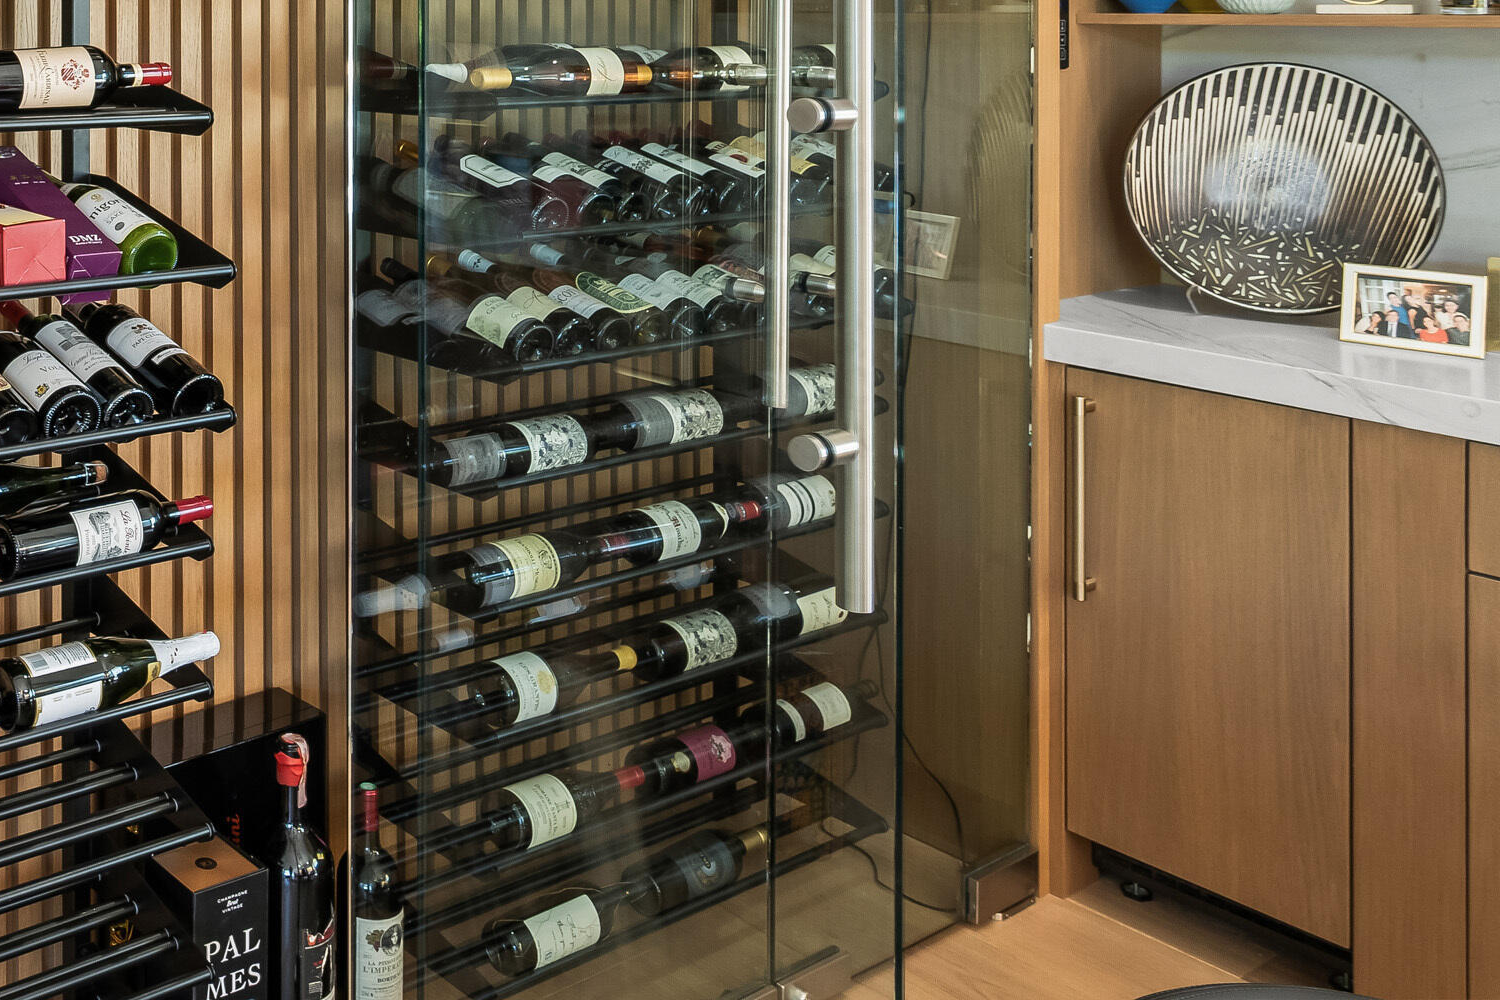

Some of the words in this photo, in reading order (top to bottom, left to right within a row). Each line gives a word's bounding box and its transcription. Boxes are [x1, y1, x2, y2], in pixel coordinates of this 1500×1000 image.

[68, 233, 102, 243] DMZ
[217, 889, 249, 904] CHAMPAGNE
[221, 902, 244, 914] VINTAGE
[203, 927, 261, 965] PAL
[205, 962, 262, 1000] MES
